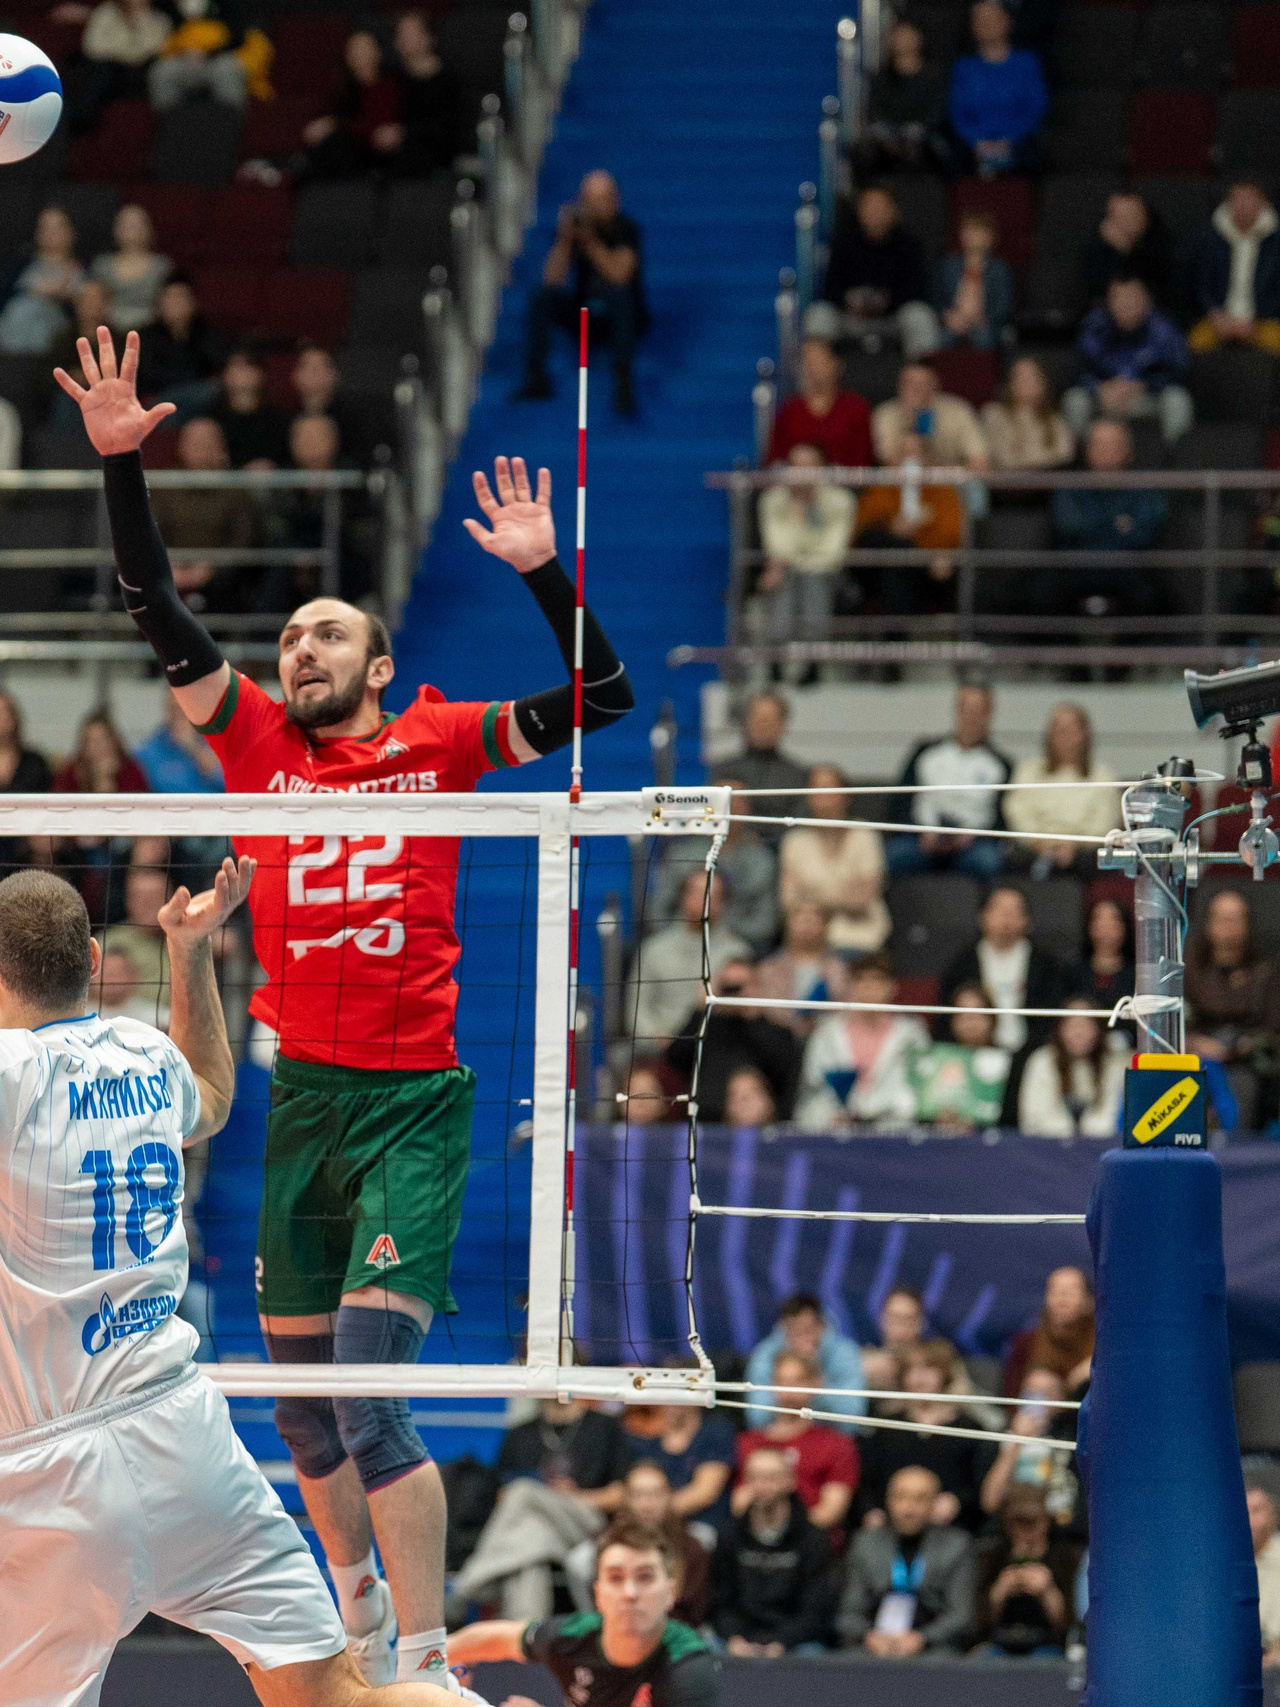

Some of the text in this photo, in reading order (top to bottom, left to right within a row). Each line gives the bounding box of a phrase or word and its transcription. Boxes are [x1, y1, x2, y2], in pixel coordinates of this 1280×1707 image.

[667, 794, 708, 803] Senoh
[288, 835, 404, 906] 22
[78, 1142, 179, 1270] 18
